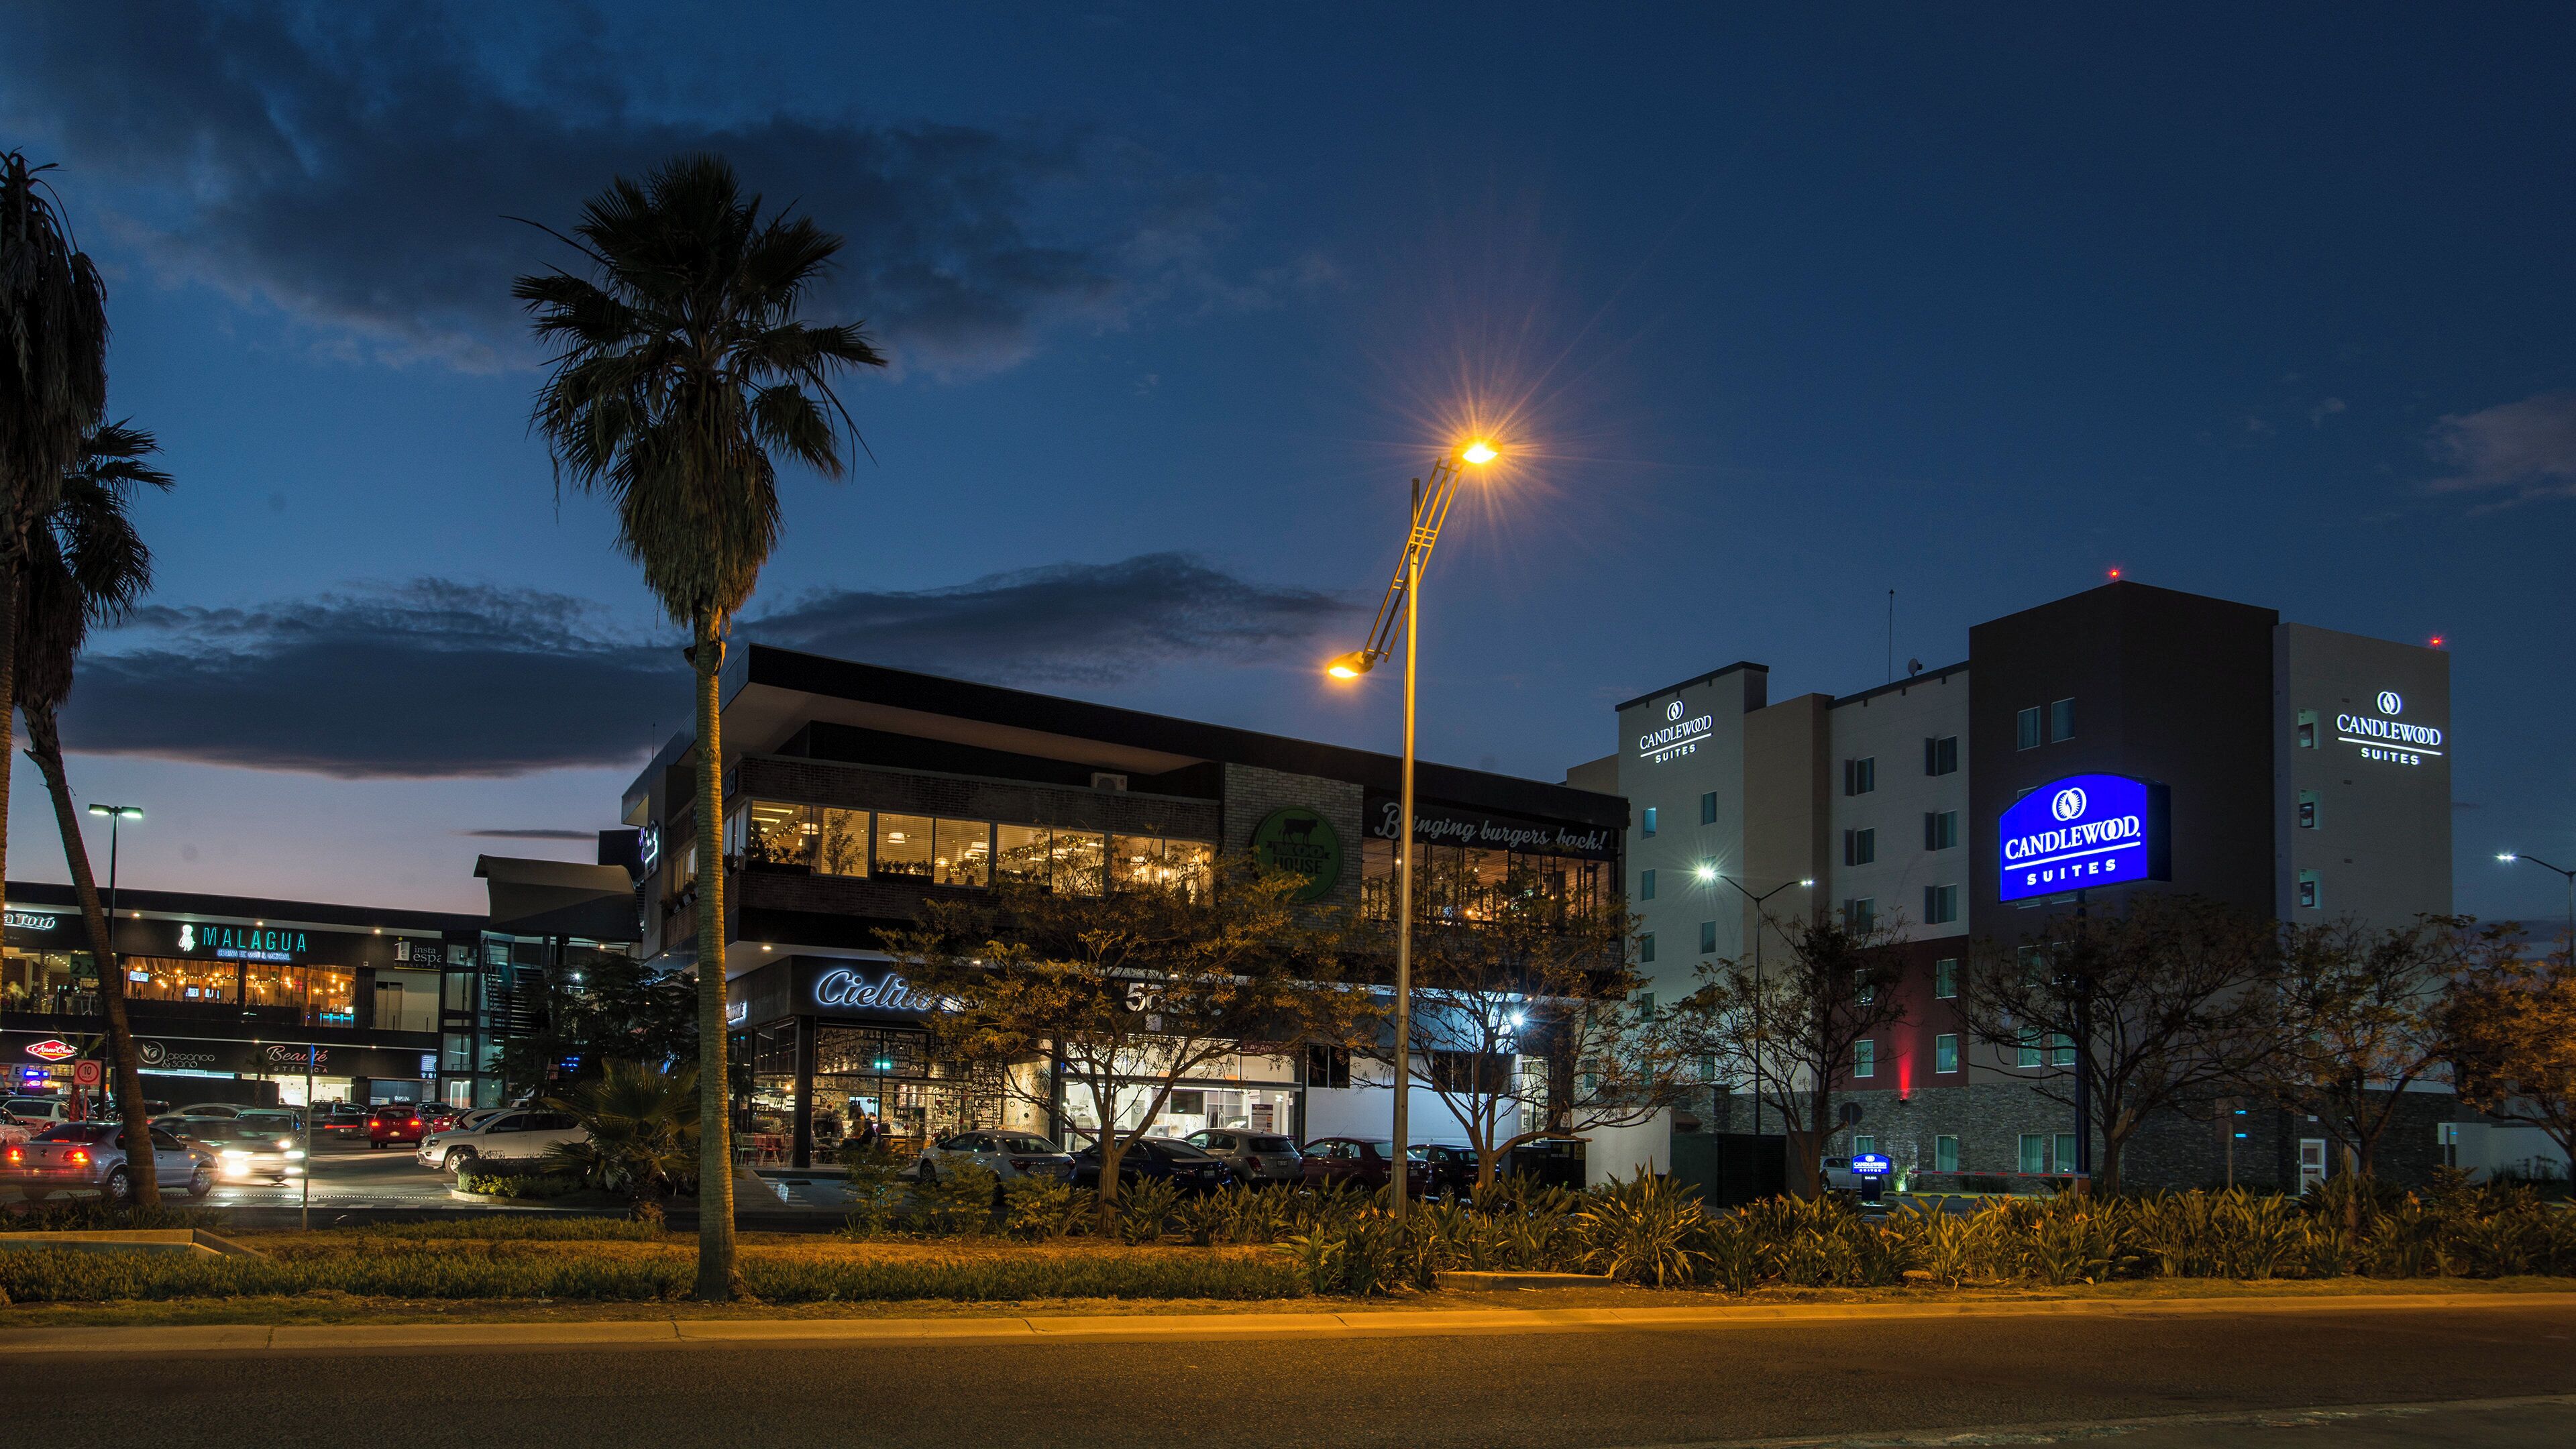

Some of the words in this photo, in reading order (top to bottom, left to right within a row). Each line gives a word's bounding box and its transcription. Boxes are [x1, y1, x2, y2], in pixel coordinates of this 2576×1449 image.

[1640, 715, 1712, 749] CANDLEWOOD
[2337, 714, 2441, 745] CANDLEWOOD
[1656, 744, 1696, 763] SUITES
[2361, 747, 2420, 765] SUITES
[1375, 802, 1476, 843] Binging
[1481, 820, 1550, 848] burgers
[1556, 827, 1607, 851] back!
[1273, 856, 1323, 874] HOUSE
[2027, 859, 2116, 885] SUITES
[203, 926, 306, 953] MALAGUA
[415, 945, 436, 954] insta
[15, 1067, 20, 1075] E
[85, 1066, 92, 1075] 10
[162, 1059, 170, 1068] &
[272, 1065, 328, 1073] STÉTCA
